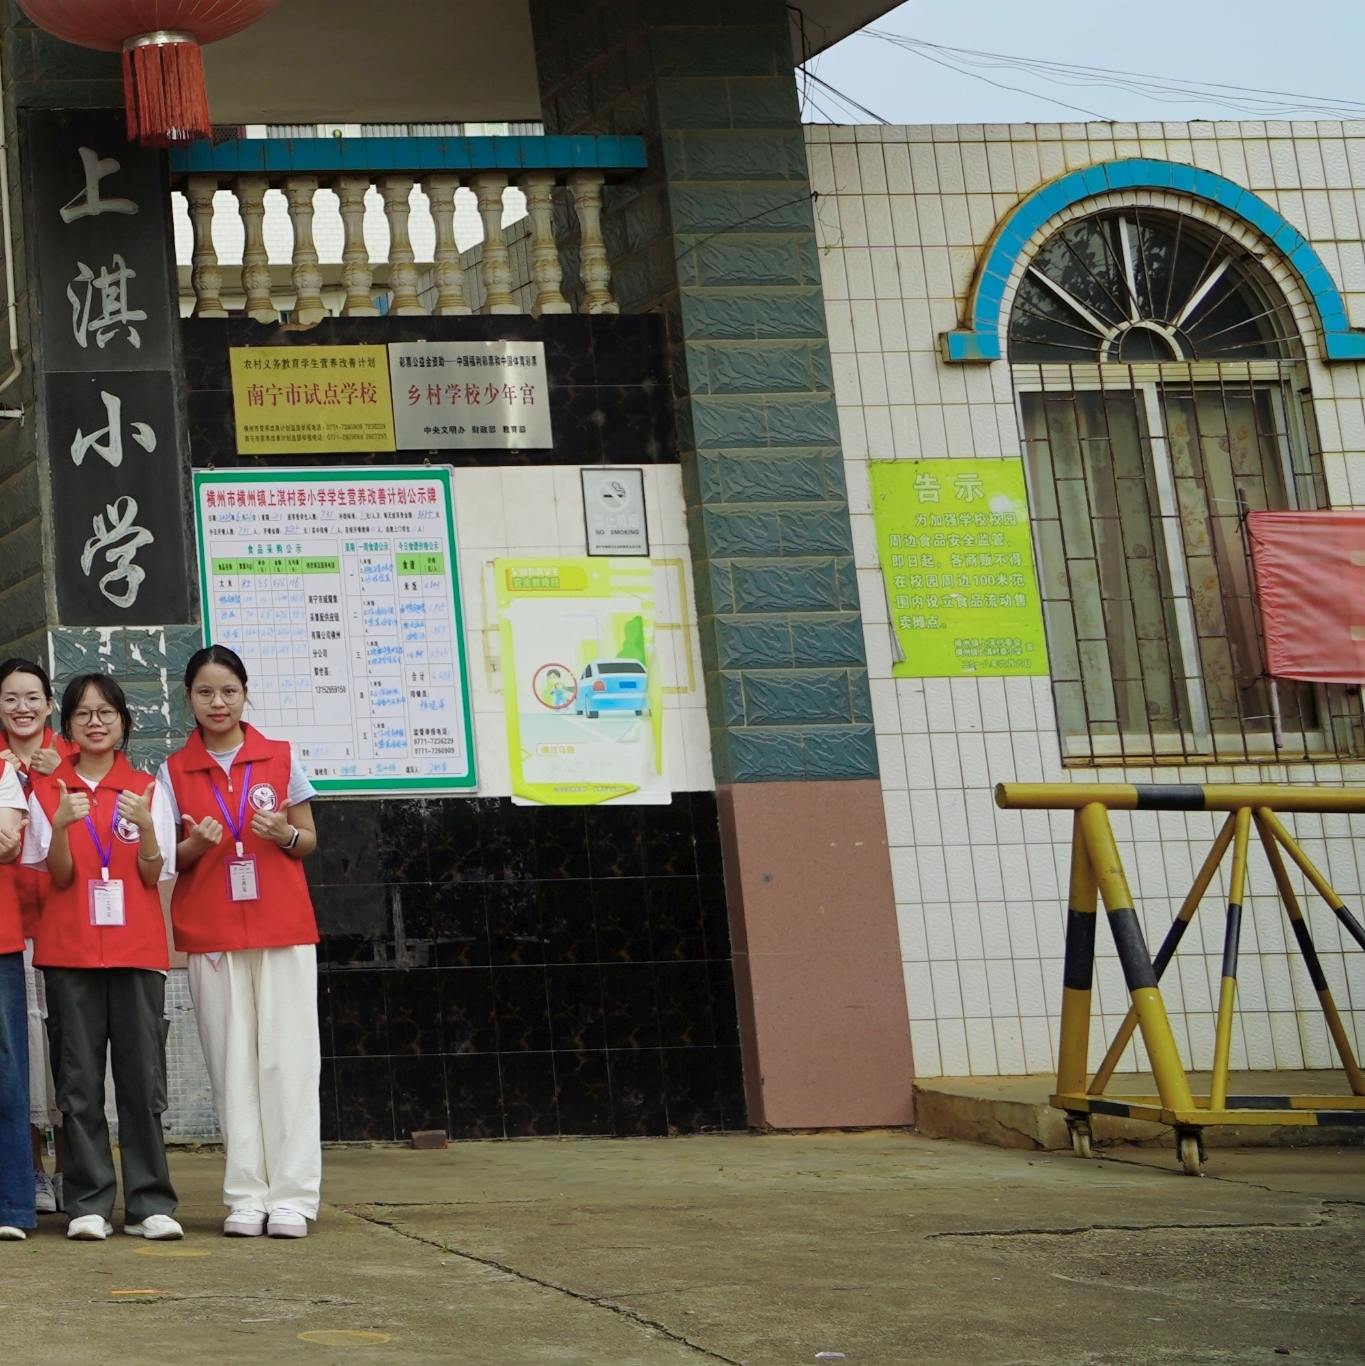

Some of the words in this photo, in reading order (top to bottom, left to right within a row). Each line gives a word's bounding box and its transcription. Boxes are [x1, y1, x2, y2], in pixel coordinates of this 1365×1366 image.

[243, 357, 376, 370] 农村义务教育学生营养改善计划
[59, 146, 157, 609] 上淇小学
[247, 382, 377, 407] 南宁市试点学校
[407, 383, 536, 407] 乡村学校少年宫
[423, 425, 466, 435] 中央文明办
[913, 472, 984, 504] 告示
[206, 487, 437, 508] 横州市横州镇上淇村委小学学生营养改善计划公示牌
[915, 512, 1017, 527] 为加强学校校园
[891, 553, 1022, 568] 即日起，各商贩不得
[893, 573, 1025, 588] 在校园周边100米范
[896, 593, 1027, 609] 围内设立食品流动售
